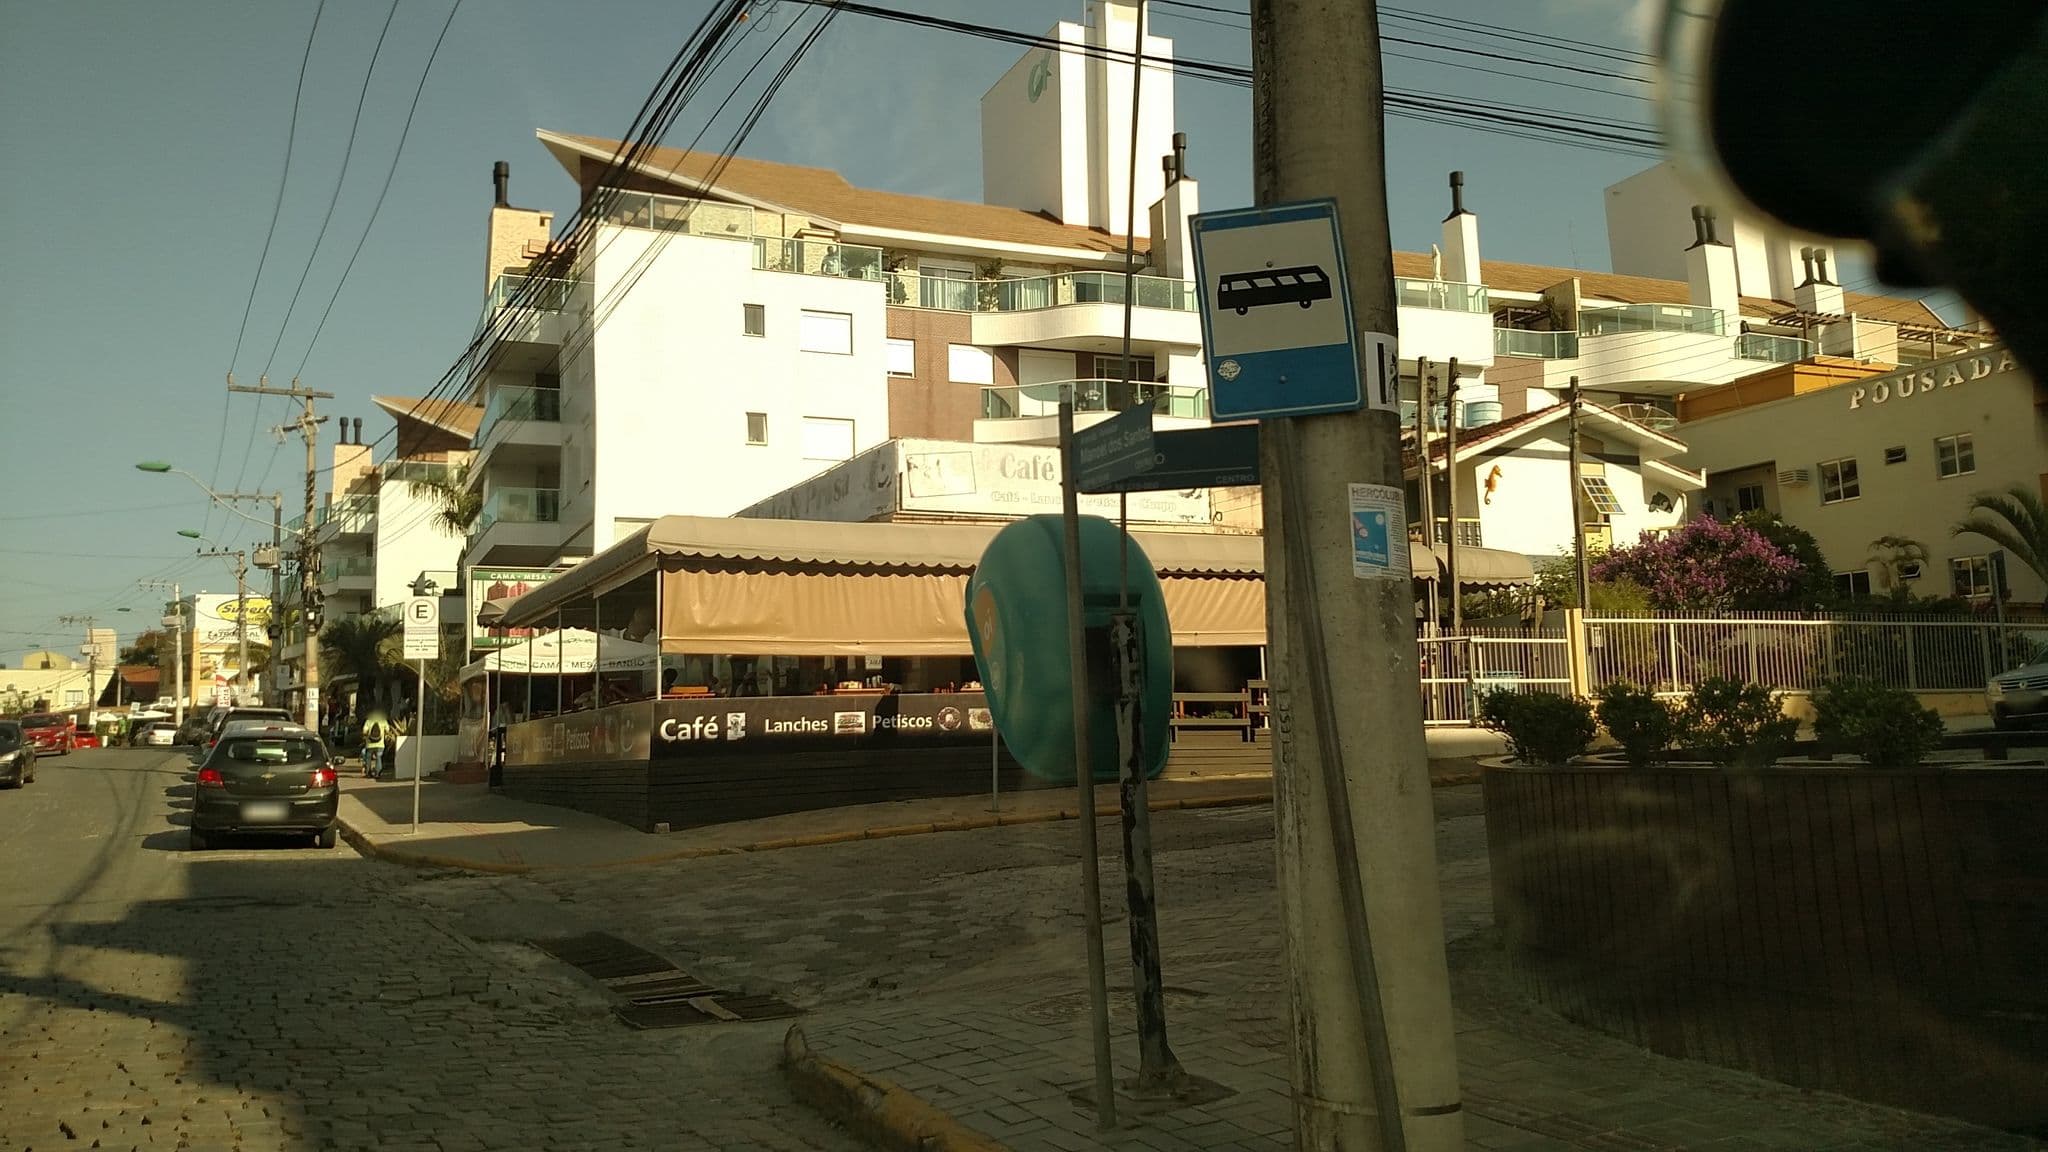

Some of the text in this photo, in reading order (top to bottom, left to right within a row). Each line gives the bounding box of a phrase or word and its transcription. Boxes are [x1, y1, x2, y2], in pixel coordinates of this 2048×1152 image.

[1850, 349, 2017, 410] POUSADA
[1000, 451, 1055, 481] Café
[1215, 473, 1256, 484] CENTRO
[490, 572, 547, 581] CAMA MESA
[416, 604, 428, 619] E
[660, 713, 933, 741] Café Lanches Petiscos
[566, 728, 590, 751] Petiscos
